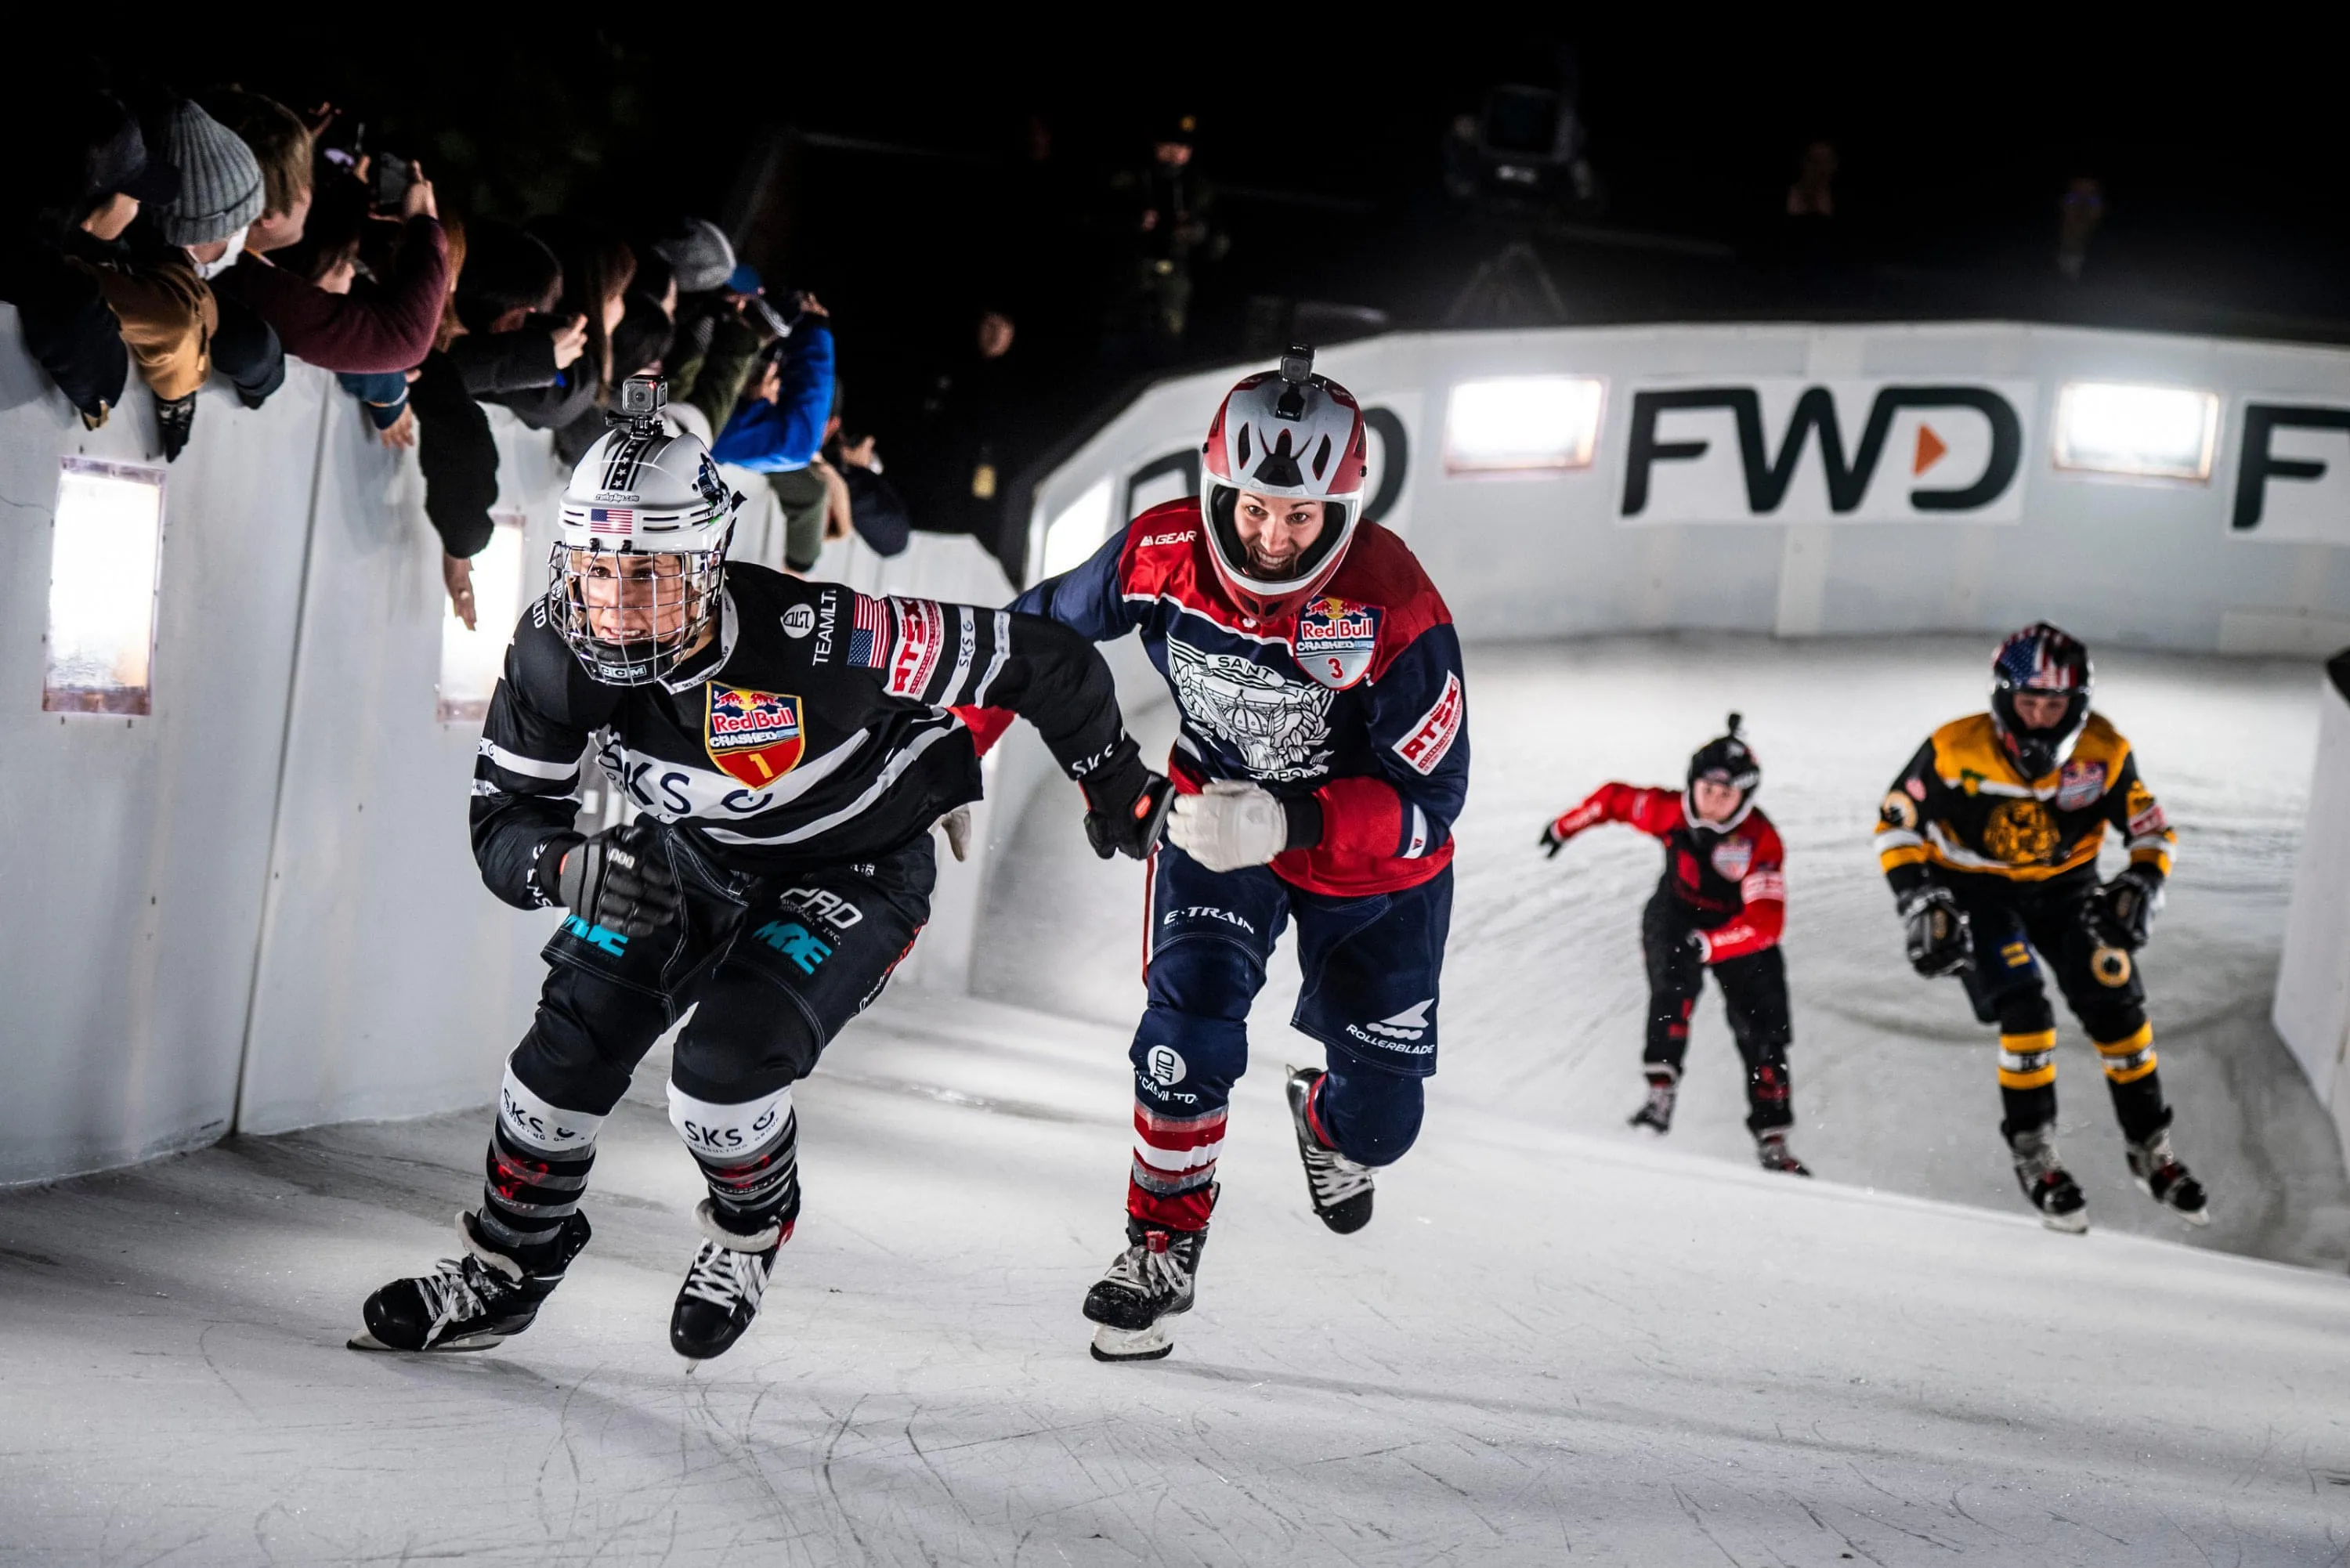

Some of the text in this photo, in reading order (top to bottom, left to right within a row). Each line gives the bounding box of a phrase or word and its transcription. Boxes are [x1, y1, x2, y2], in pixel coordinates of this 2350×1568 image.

[1621, 385, 2023, 517] FWD
[1155, 530, 1197, 545] GEAR
[812, 590, 837, 666] TEAMLT
[1300, 618, 1373, 640] Red Bull
[601, 665, 646, 679] CCM
[1217, 656, 1274, 679] SAINT
[1328, 658, 1343, 679] 3
[711, 710, 755, 734] Red
[752, 707, 796, 729] Bull
[709, 731, 777, 747] CRASHED
[598, 739, 692, 815] SKS
[748, 753, 774, 779] 1
[1346, 1024, 1435, 1054] ROLLERBLADE
[685, 1120, 743, 1149] SKS
